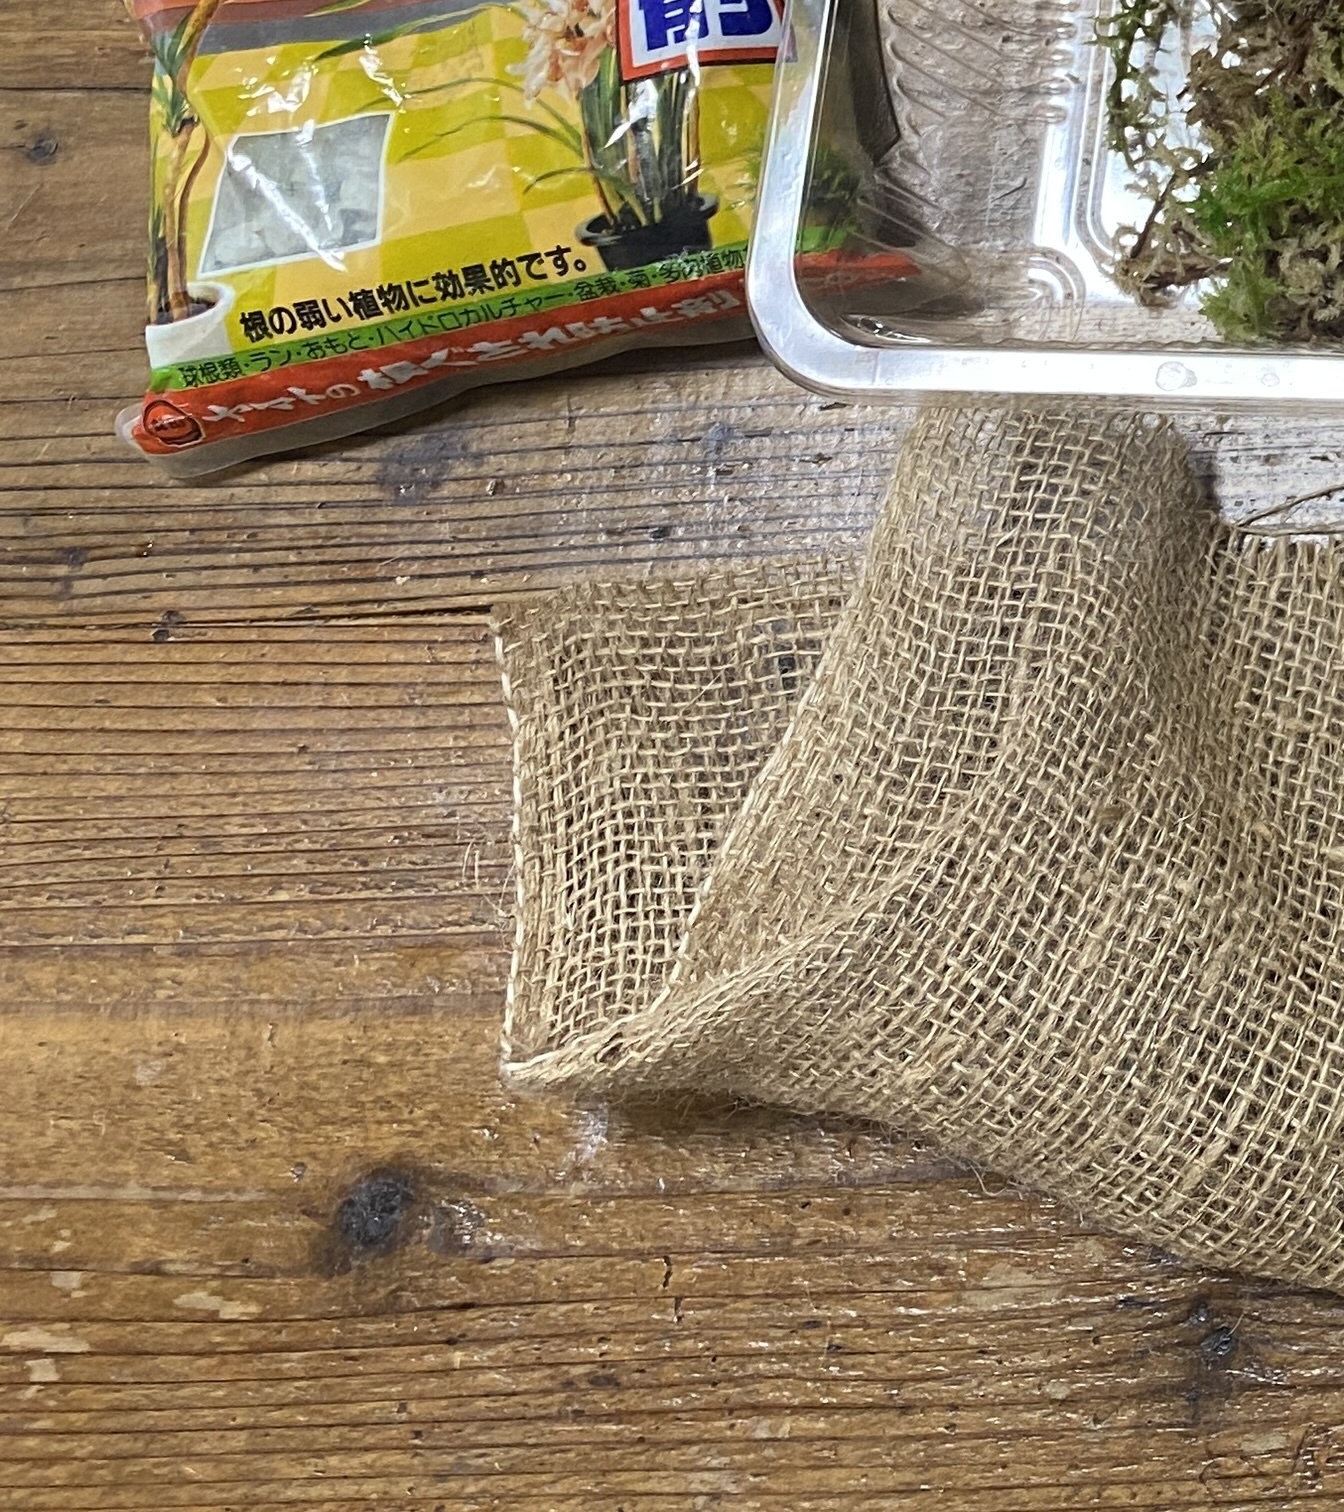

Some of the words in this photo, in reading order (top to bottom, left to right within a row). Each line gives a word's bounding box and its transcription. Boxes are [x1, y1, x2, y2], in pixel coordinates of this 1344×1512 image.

[239, 244, 588, 344] 根の弱い植物に効果的です。
